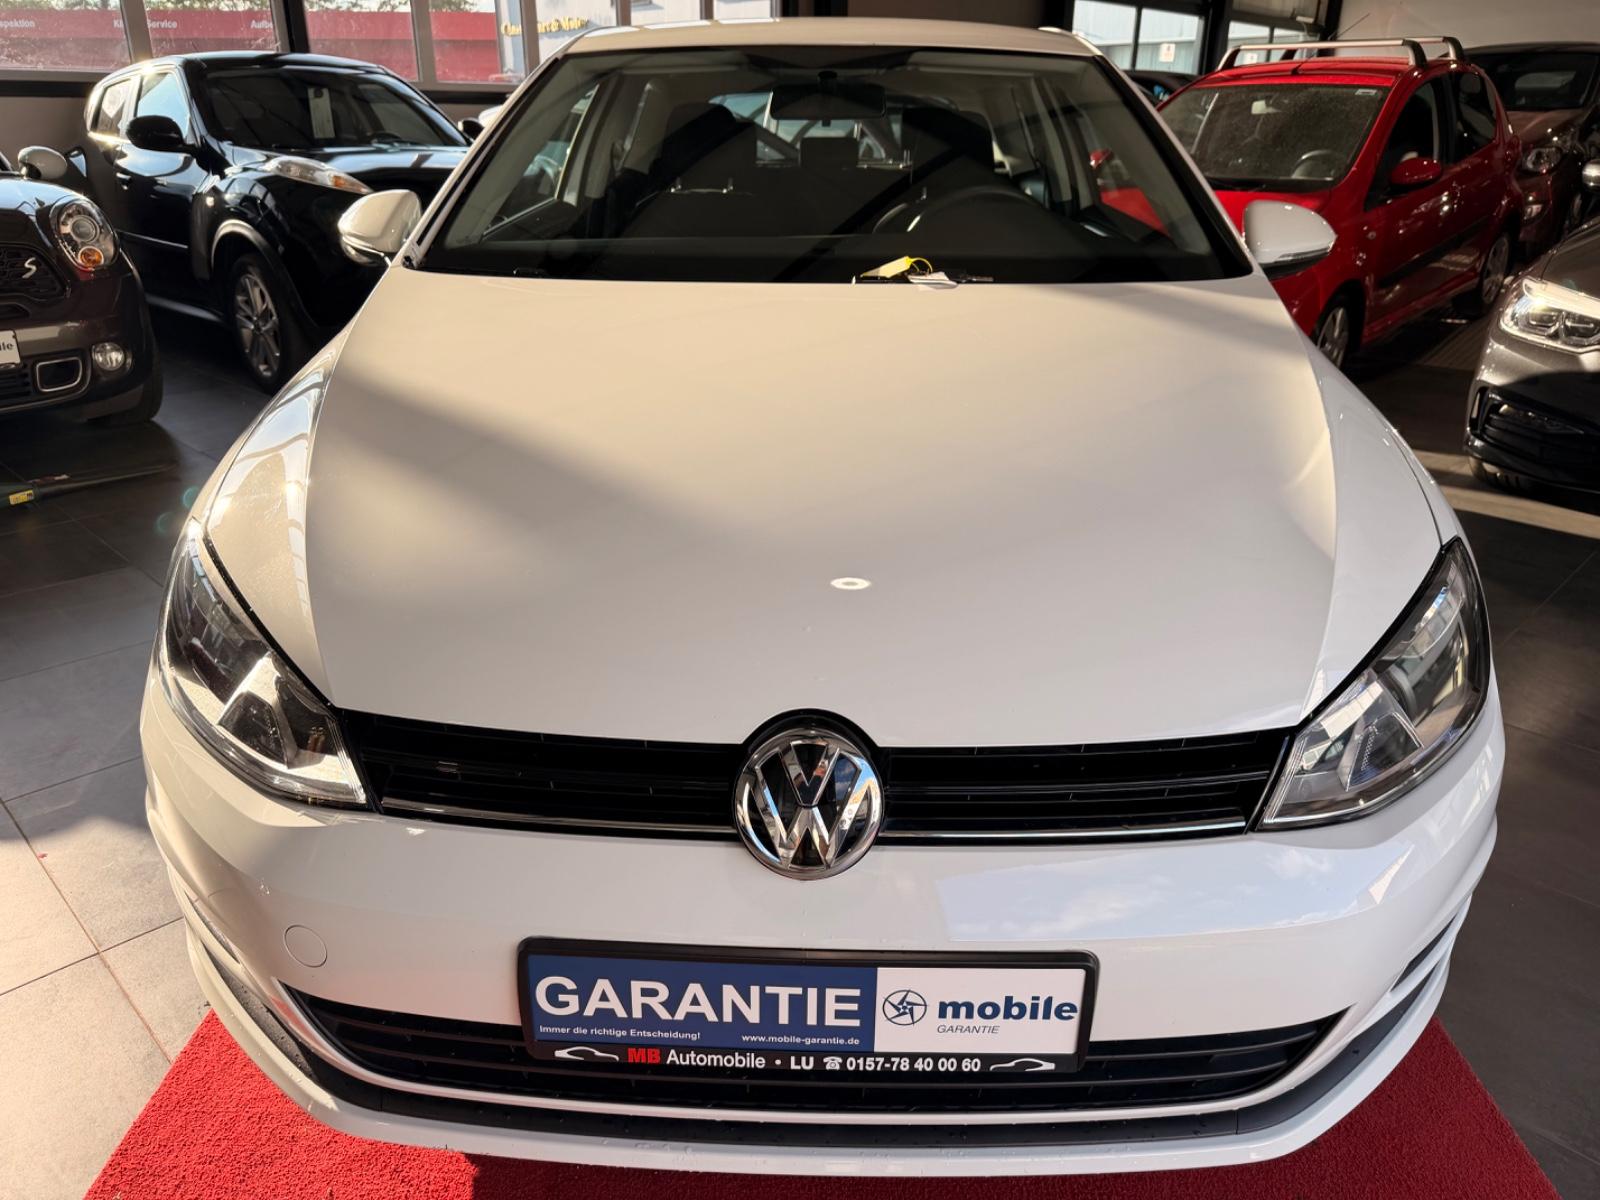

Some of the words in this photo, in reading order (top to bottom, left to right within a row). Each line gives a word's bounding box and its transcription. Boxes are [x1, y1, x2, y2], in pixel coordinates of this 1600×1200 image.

[22, 257, 37, 279] S
[0, 341, 14, 351] le
[535, 976, 861, 1027] GARANTIE
[938, 996, 1078, 1021] mobile
[539, 1025, 570, 1034] Immer
[573, 1026, 588, 1035] die
[590, 1027, 627, 1037] richtige
[630, 1029, 701, 1041] Entscheidung!
[937, 1024, 1000, 1034] GARANTIE
[742, 1034, 860, 1045] www.mobile-garantie.de
[628, 1048, 661, 1064] MB
[666, 1049, 766, 1069] Automobile
[790, 1056, 814, 1070] LU
[846, 1057, 910, 1071] 0157-78
[914, 1057, 934, 1071] 40
[938, 1058, 957, 1072] 00
[961, 1058, 981, 1072] 60
